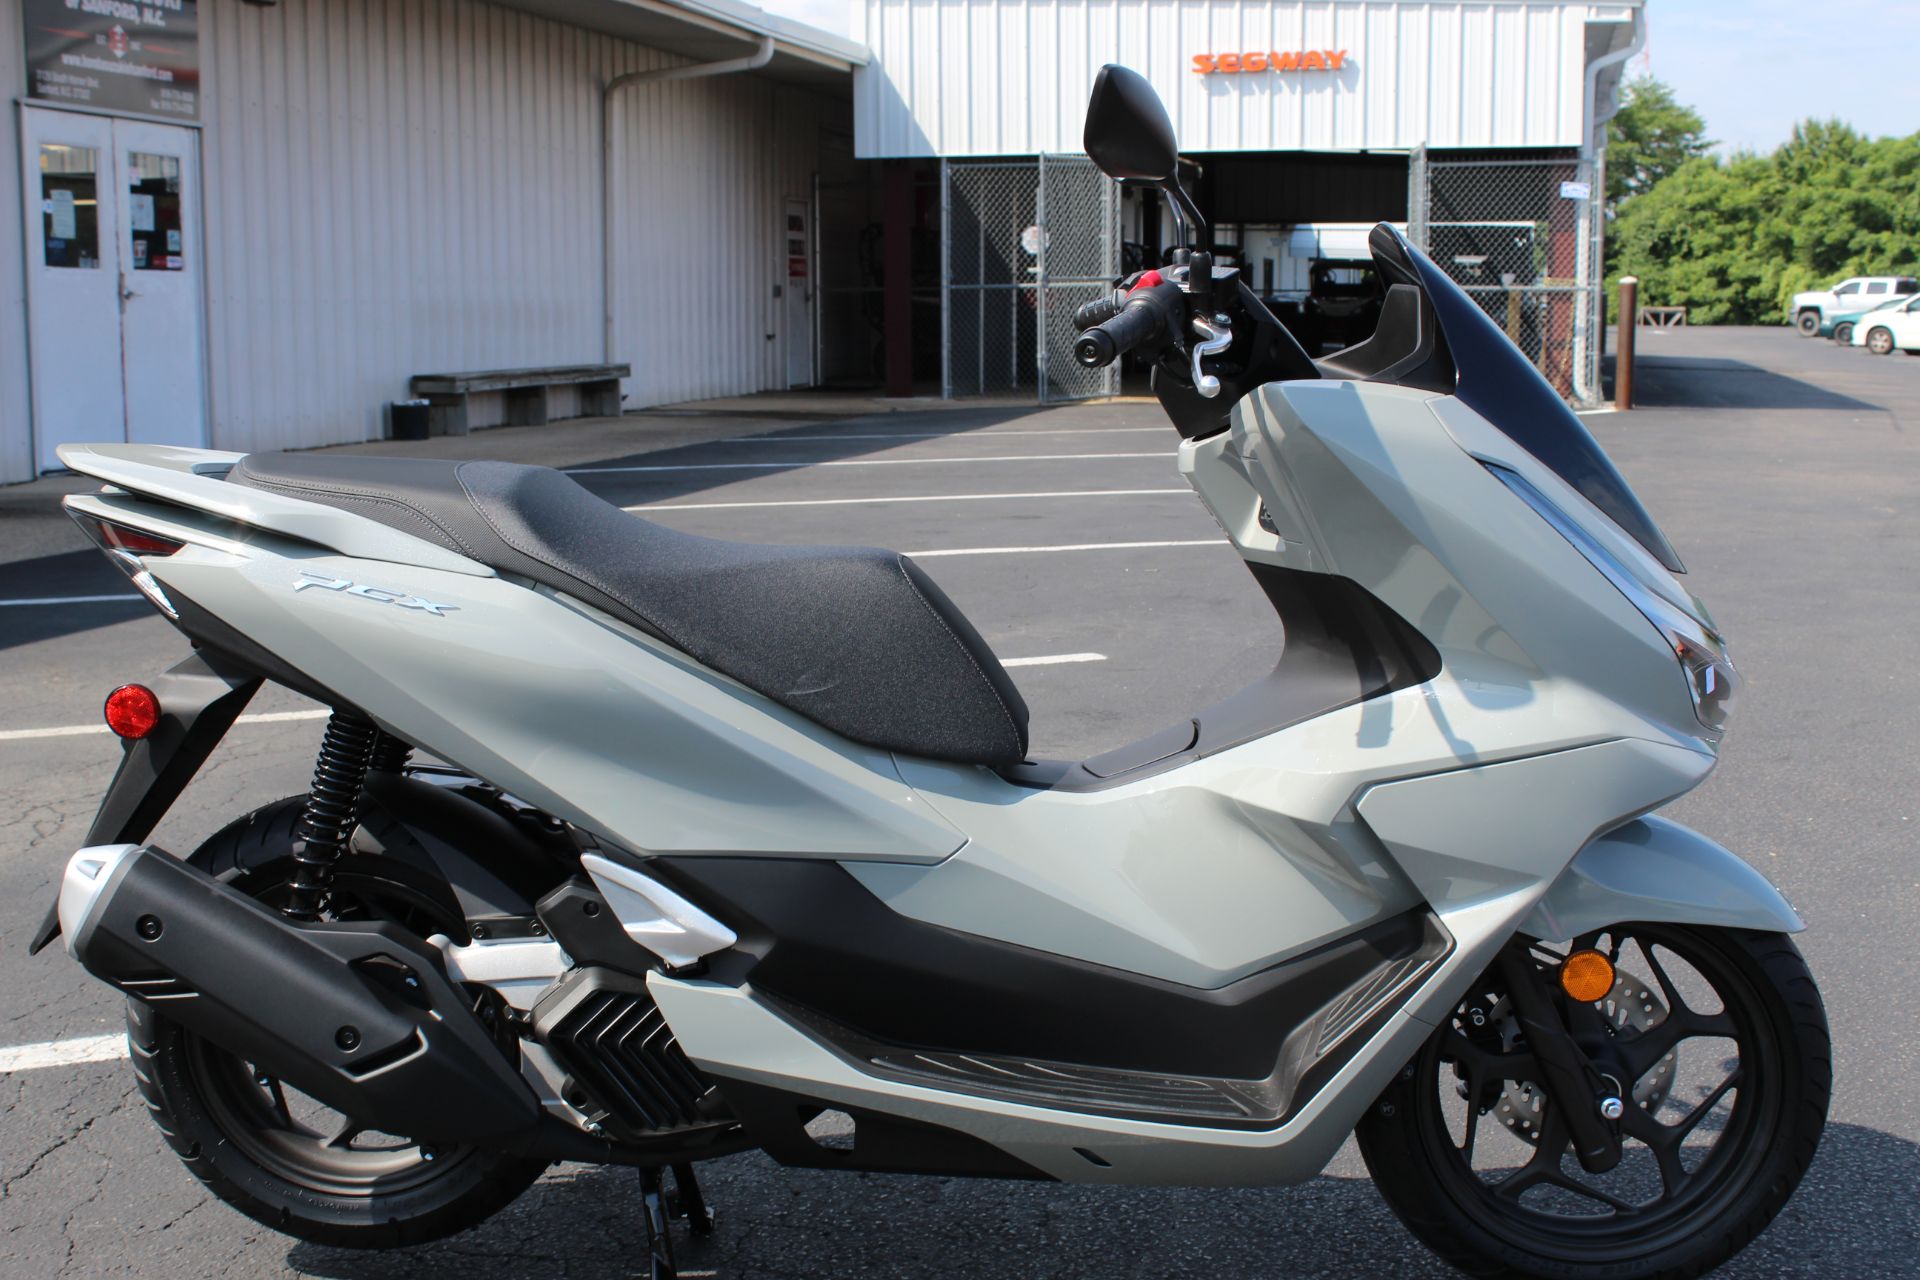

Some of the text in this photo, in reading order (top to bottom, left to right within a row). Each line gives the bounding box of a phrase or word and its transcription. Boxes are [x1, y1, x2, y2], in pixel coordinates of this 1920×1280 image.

[142, 7, 166, 27] N.C.
[1191, 50, 1348, 74] SEGWAY
[292, 569, 462, 617] PCX
